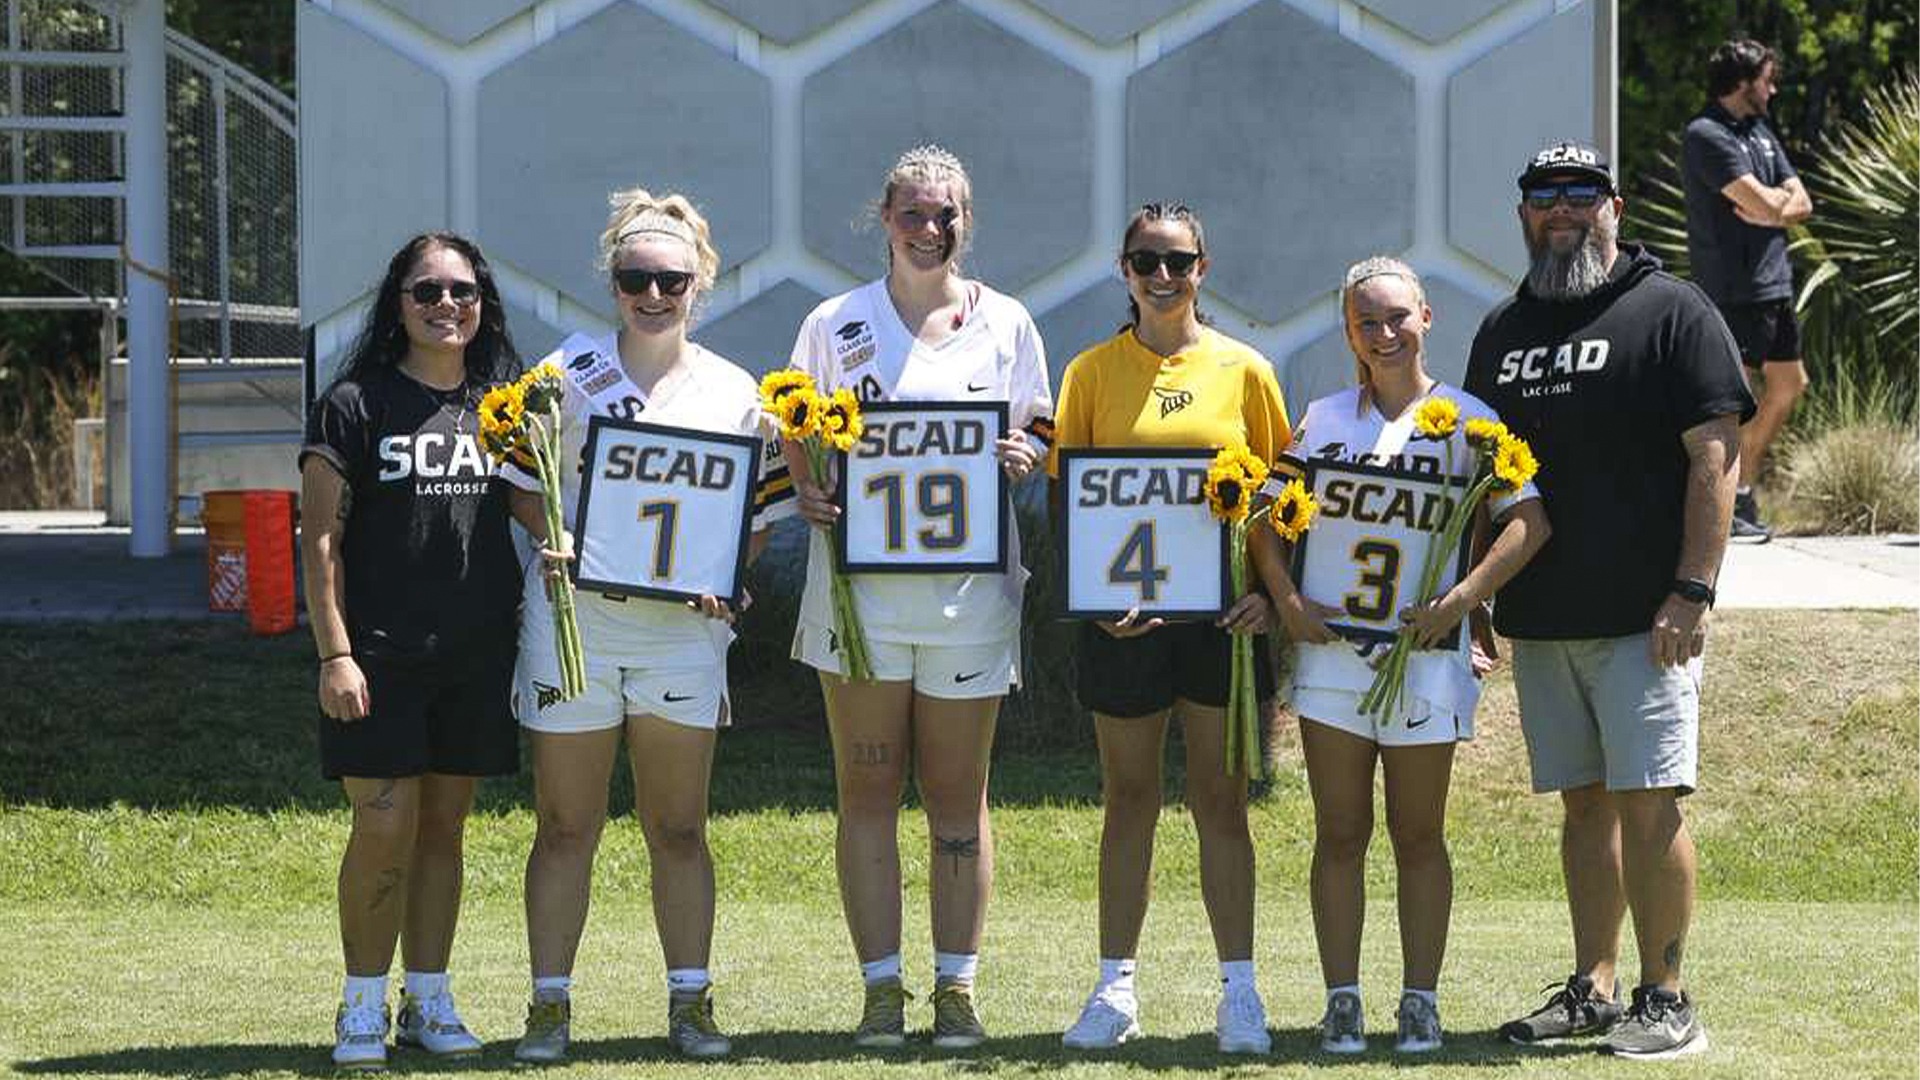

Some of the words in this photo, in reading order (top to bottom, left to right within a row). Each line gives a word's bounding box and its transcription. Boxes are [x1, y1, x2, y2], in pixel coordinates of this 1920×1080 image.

[1535, 146, 1596, 167] SCAD
[1497, 339, 1611, 384] SCAD
[857, 420, 985, 459] SCAD
[416, 482, 488, 496] LACROSSE
[604, 444, 736, 491] SCAD
[1078, 467, 1208, 507] SCAD
[864, 469, 971, 553] 19
[1320, 479, 1454, 532] SCAD
[637, 498, 682, 582] 1
[1108, 517, 1171, 604] 4
[1342, 535, 1402, 623] 3
